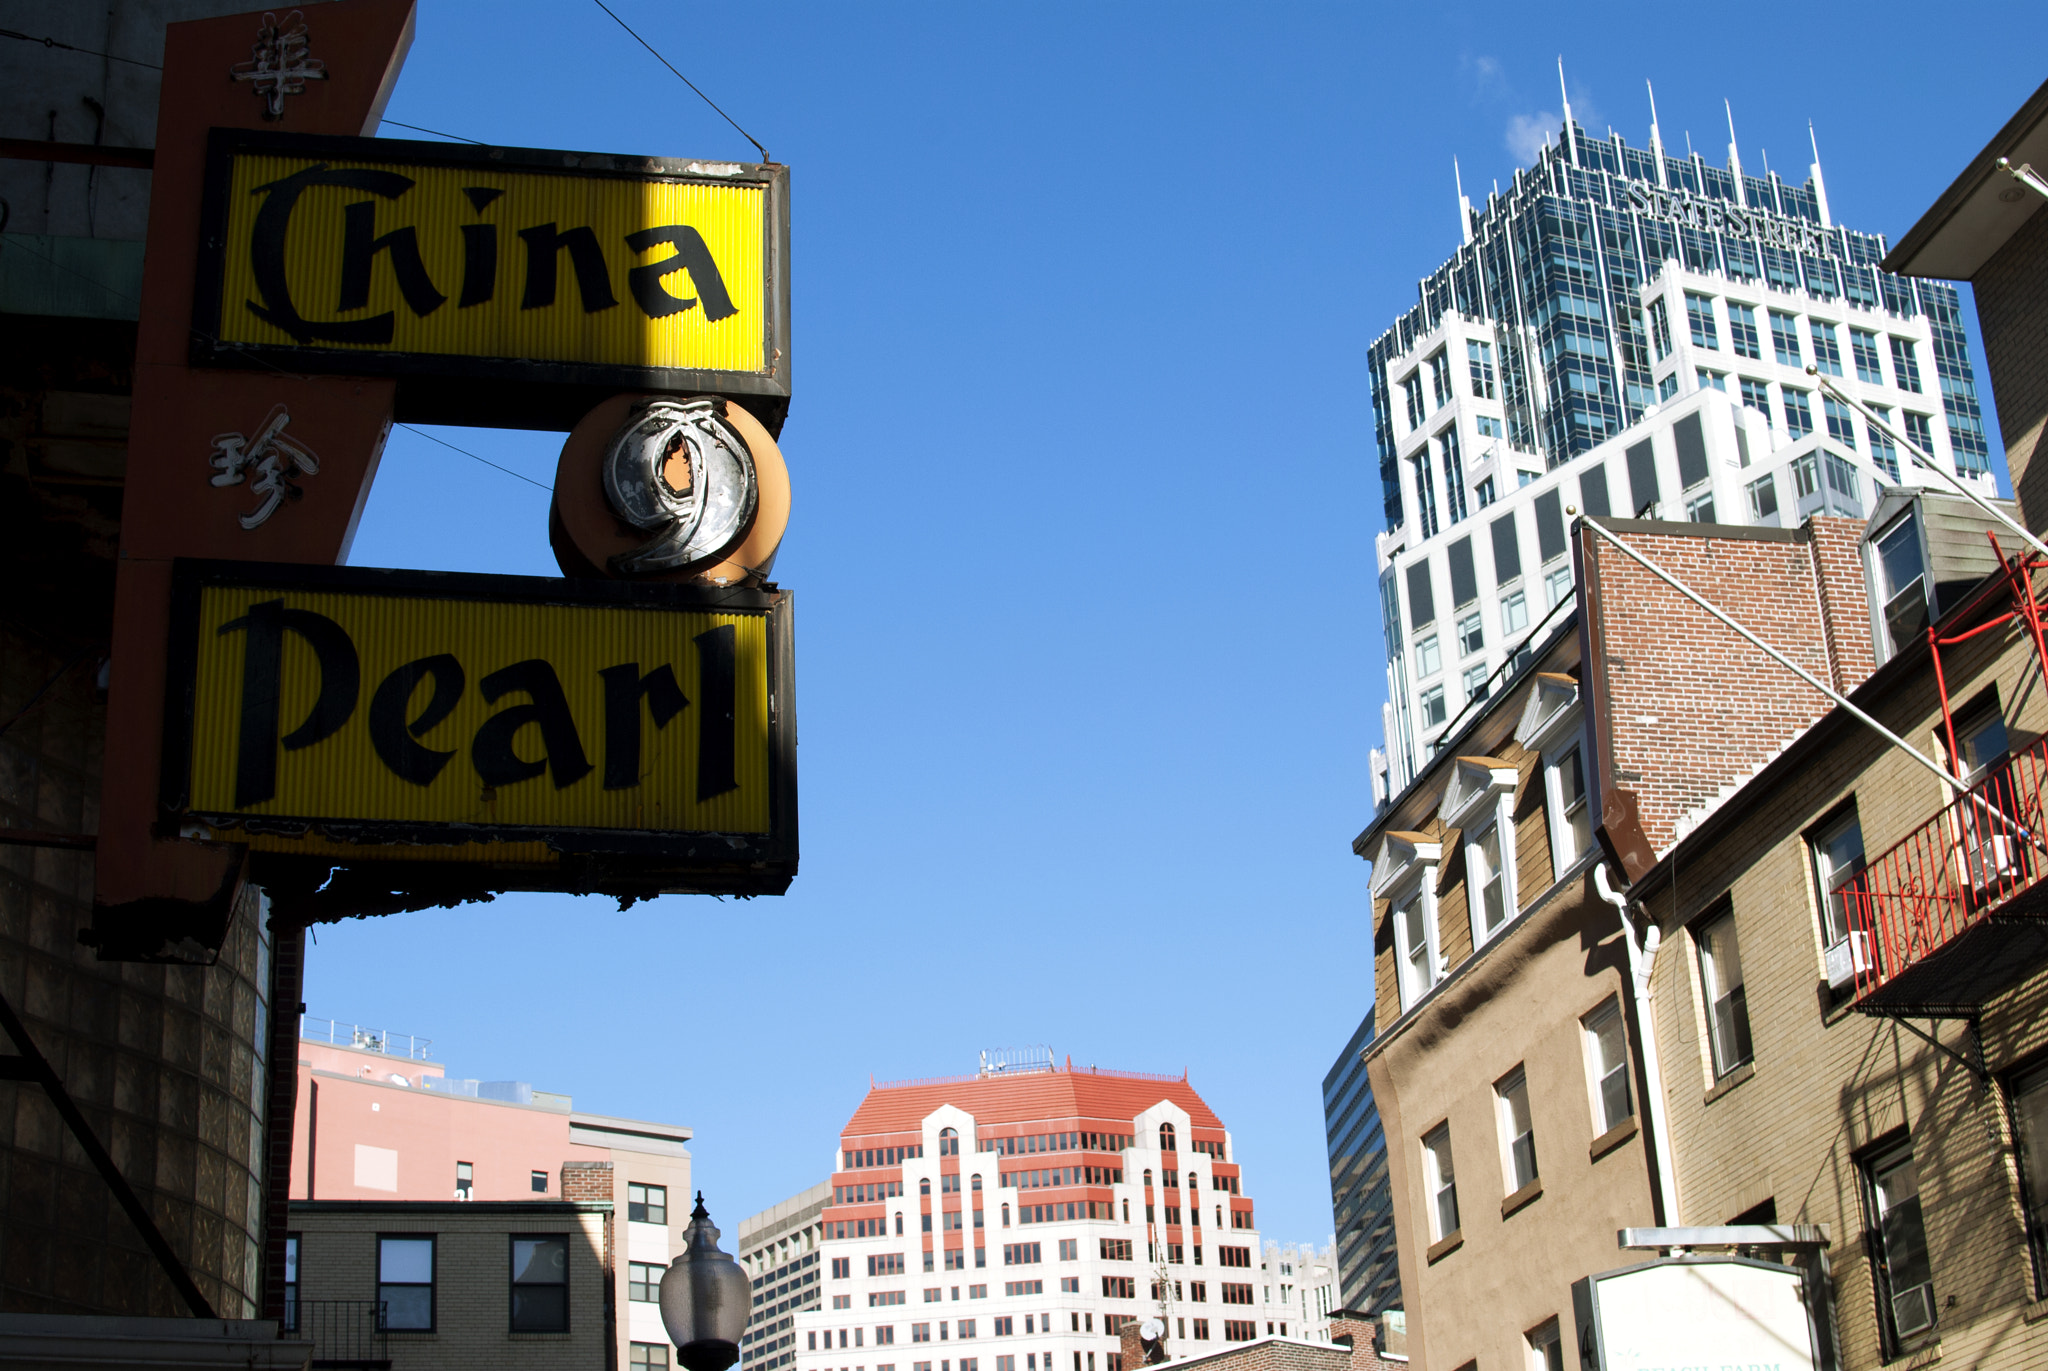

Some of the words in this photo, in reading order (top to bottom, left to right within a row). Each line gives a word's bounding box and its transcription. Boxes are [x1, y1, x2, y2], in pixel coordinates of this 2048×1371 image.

[246, 164, 739, 344] China
[1628, 181, 1724, 231] STATE
[1727, 205, 1834, 257] STREET
[218, 599, 740, 808] Pearl
